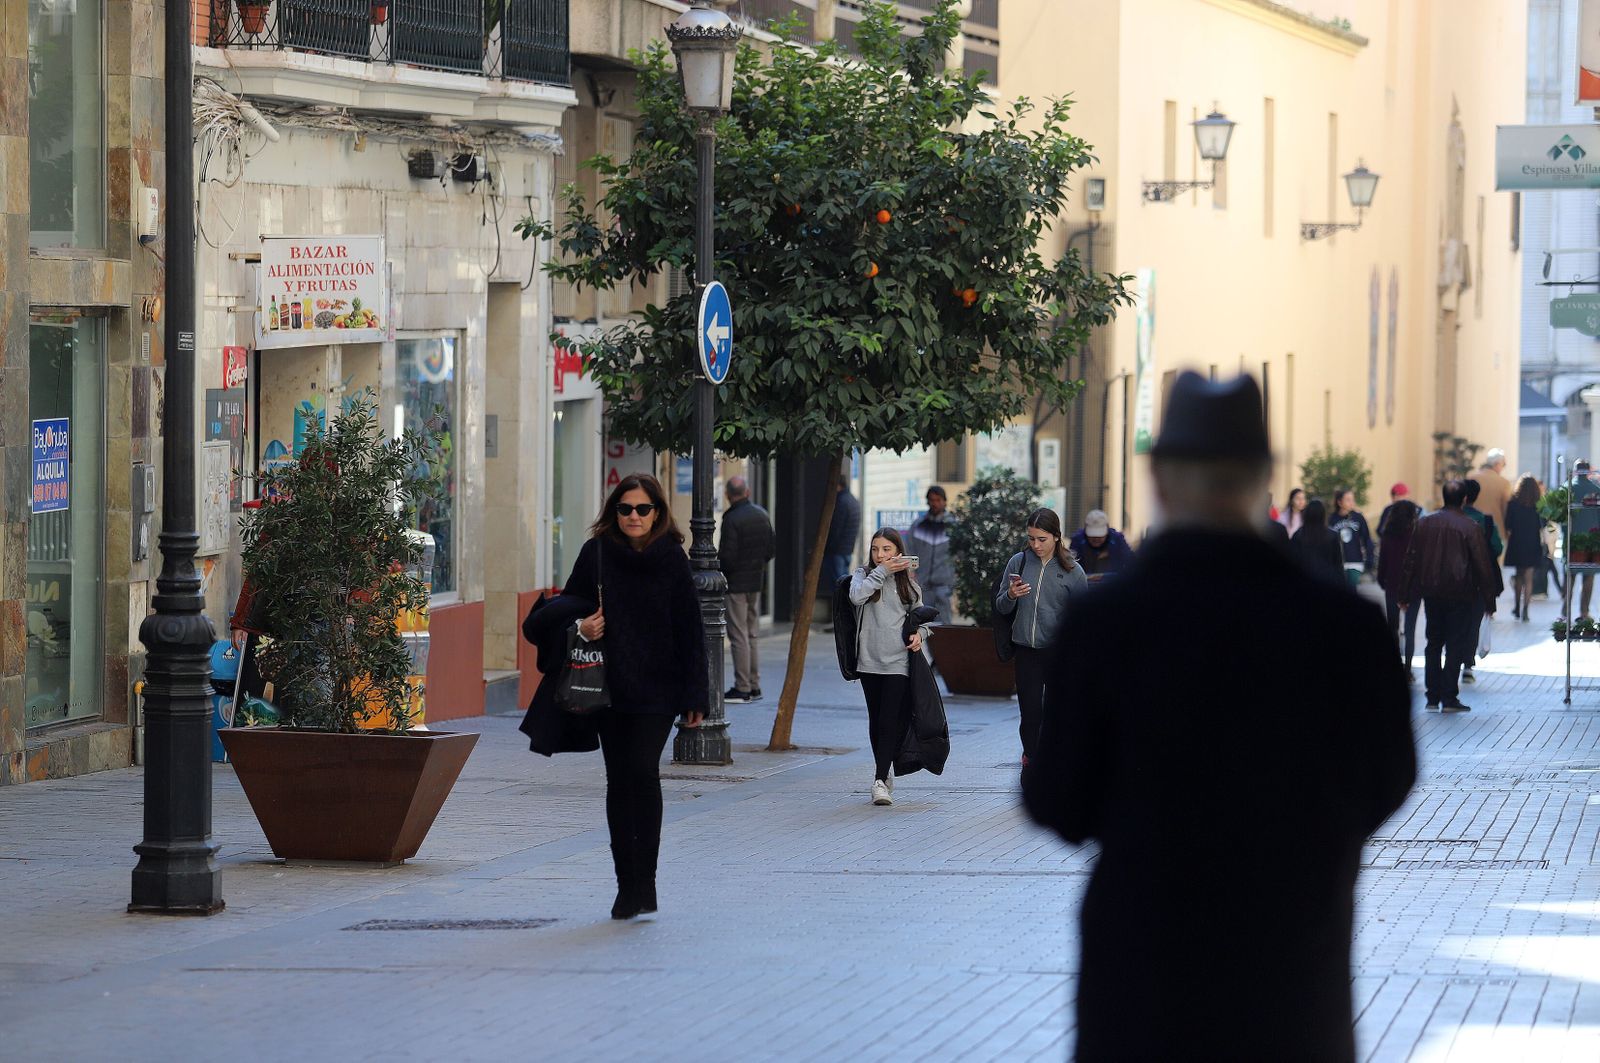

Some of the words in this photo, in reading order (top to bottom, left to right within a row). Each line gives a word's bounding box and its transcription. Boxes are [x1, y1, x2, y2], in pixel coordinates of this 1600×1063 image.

[290, 245, 348, 260] BAZAR
[268, 259, 375, 278] ALIMENTACIÓN
[284, 280, 294, 293] Y
[297, 279, 358, 292] FRUTAS
[36, 461, 65, 481] ALQUILA
